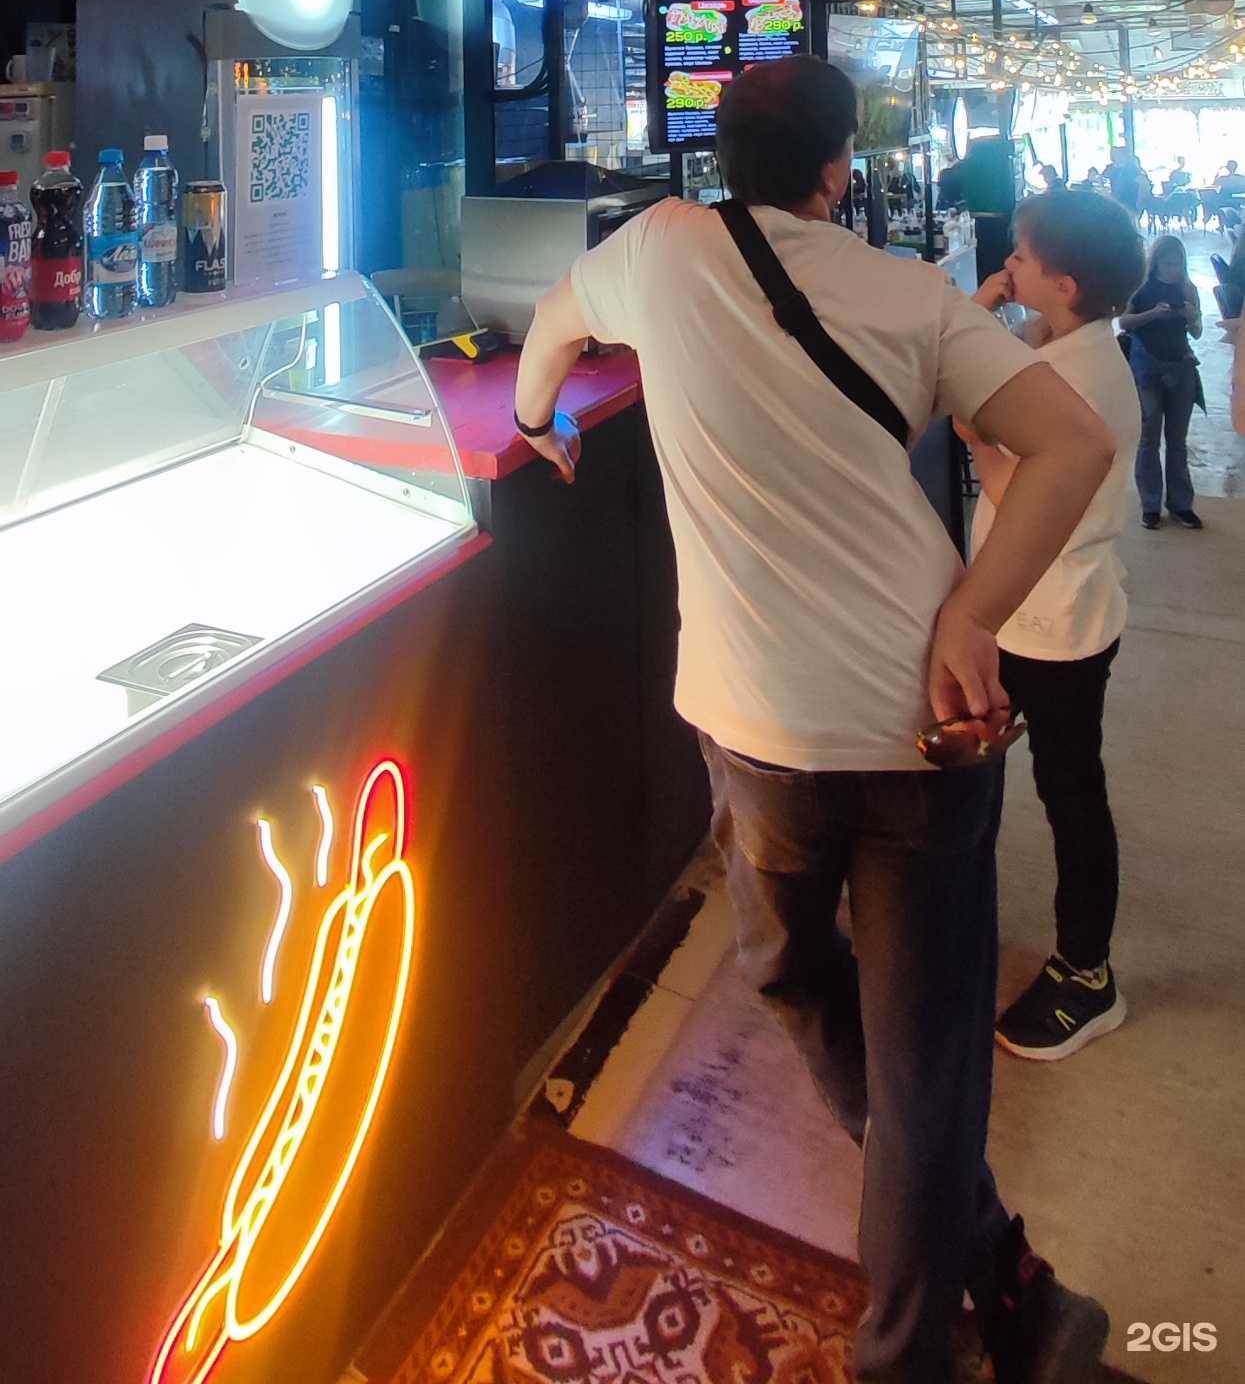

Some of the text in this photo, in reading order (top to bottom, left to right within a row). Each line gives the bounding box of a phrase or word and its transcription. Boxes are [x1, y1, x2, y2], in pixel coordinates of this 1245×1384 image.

[766, 20, 791, 30] 290
[665, 32, 693, 43] 250
[666, 98, 694, 109] 290
